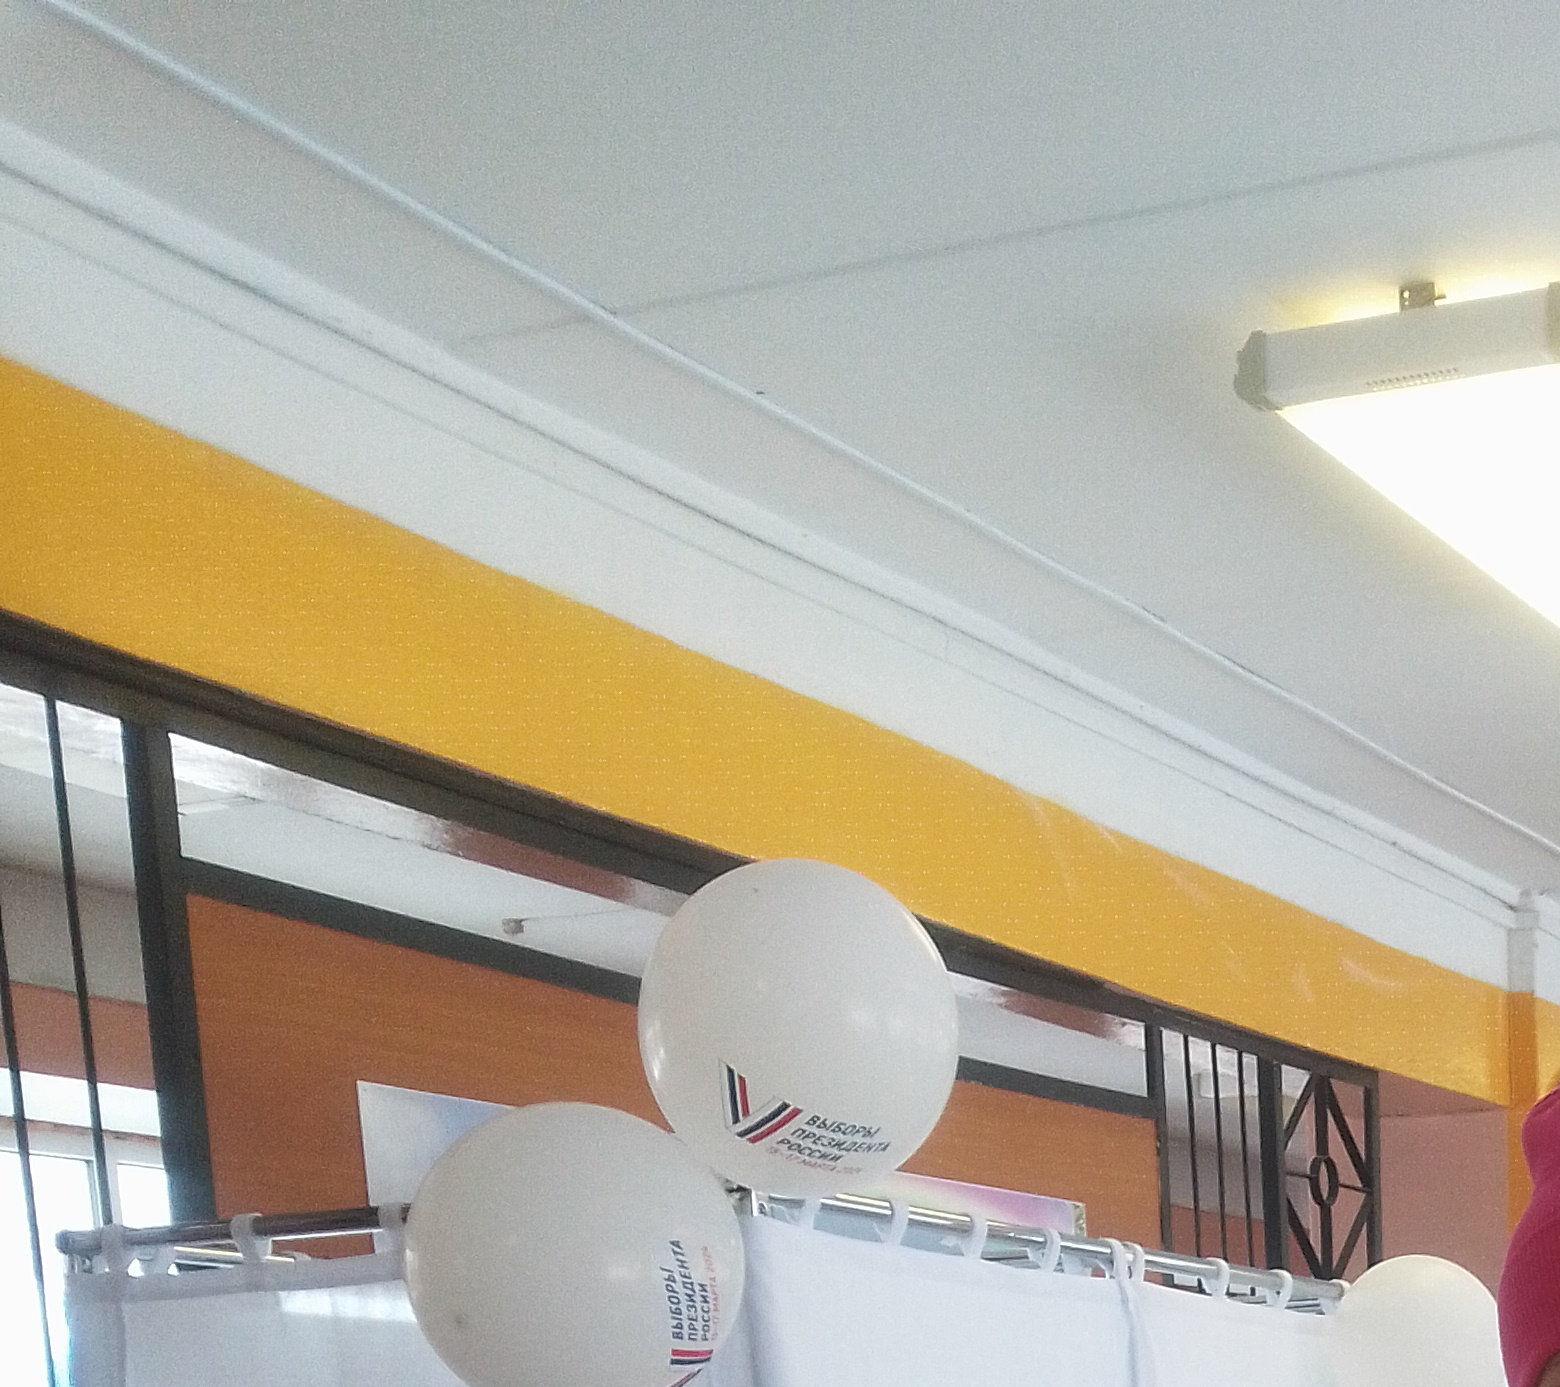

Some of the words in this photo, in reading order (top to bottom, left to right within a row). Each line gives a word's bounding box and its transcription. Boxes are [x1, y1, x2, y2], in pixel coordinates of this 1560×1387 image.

[790, 1127, 891, 1153] ПРЕЗИДЕНТА
[805, 1114, 880, 1138] ВЫБОРЫ
[776, 1138, 844, 1163] РОССИИ
[660, 1266, 684, 1340] ВЫБОРЫ
[668, 1240, 698, 1342] ПРЕЗИДЕНТА
[697, 1282, 710, 1342] РОССИИ
